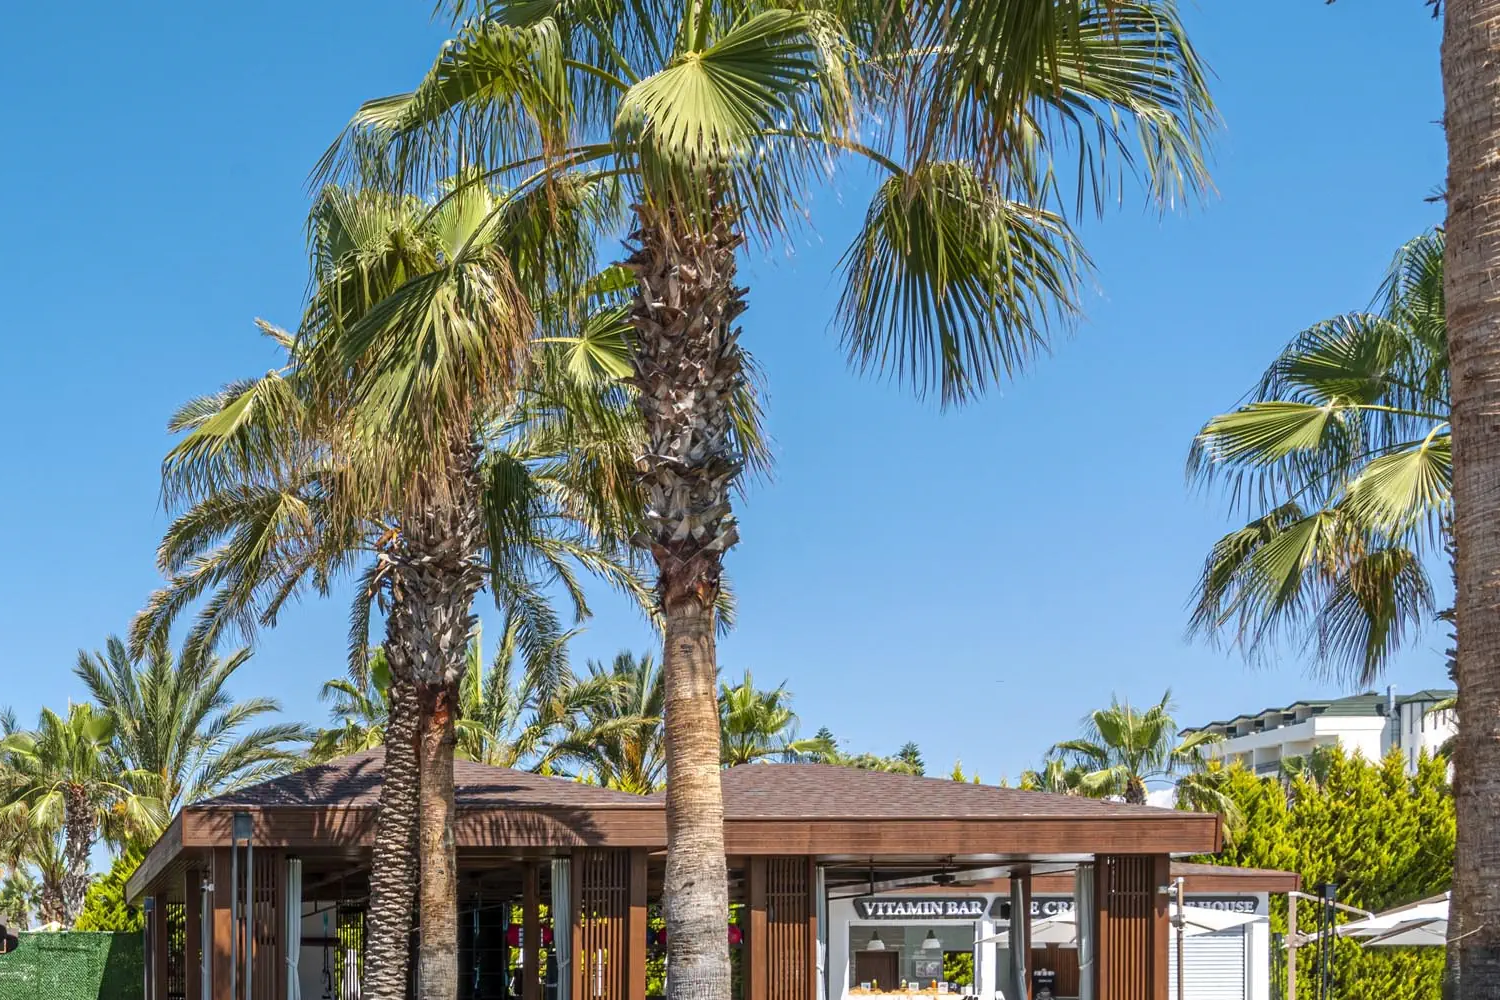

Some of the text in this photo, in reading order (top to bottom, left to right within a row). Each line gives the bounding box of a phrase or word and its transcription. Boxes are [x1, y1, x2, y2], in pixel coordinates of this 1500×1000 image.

[863, 901, 983, 916] VITAMIN BAR
[1198, 901, 1254, 913] HOUSE
